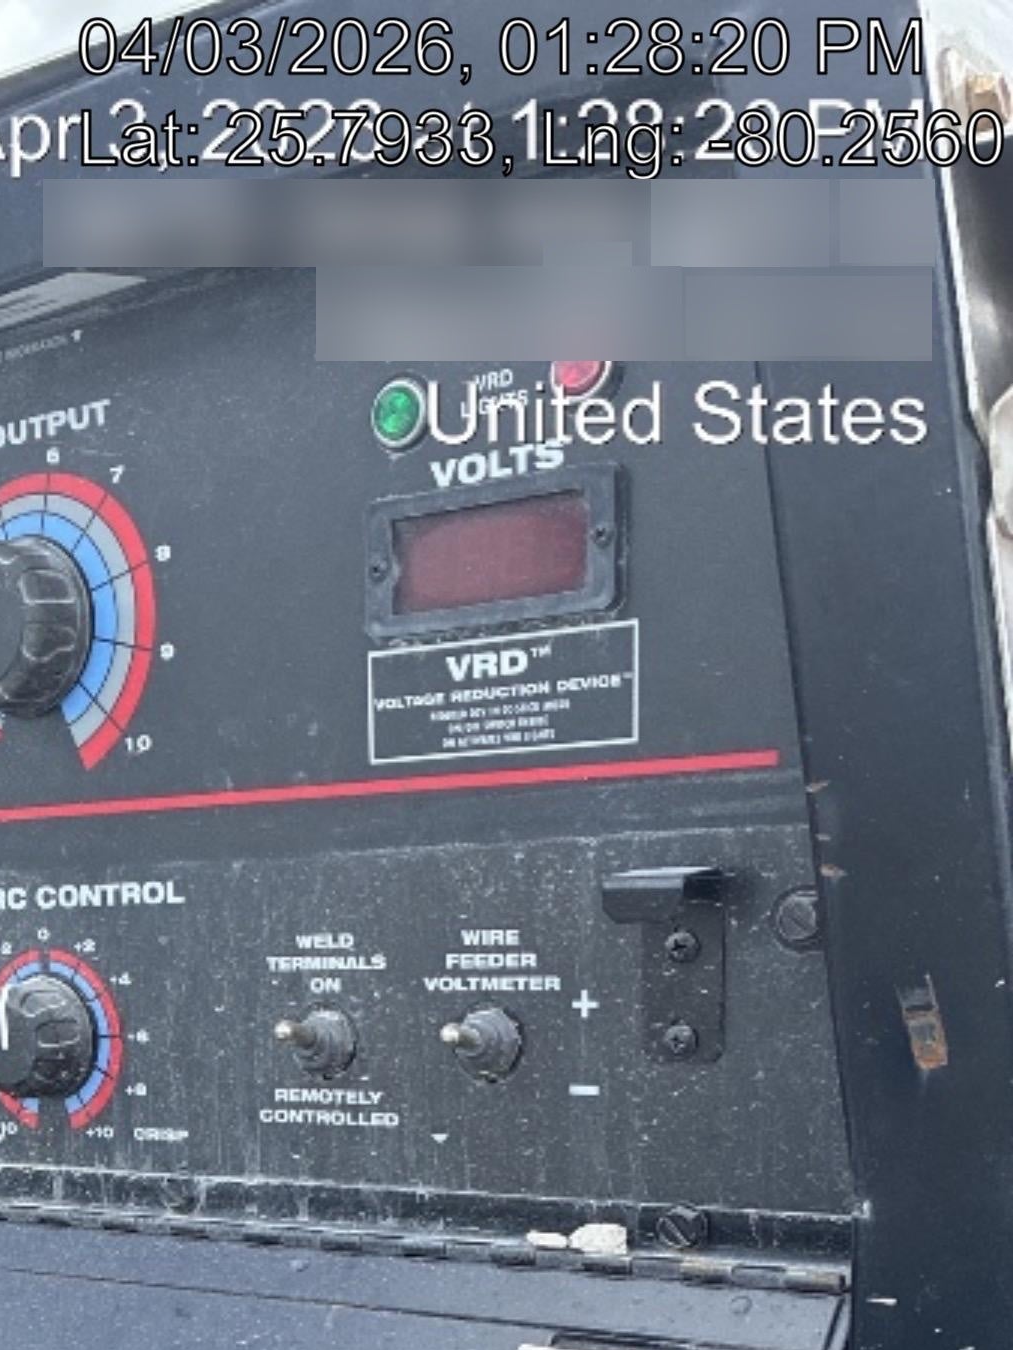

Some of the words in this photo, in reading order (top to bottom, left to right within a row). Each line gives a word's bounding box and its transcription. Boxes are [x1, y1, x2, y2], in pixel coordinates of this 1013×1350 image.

[46, 448, 60, 464] 6
[430, 438, 565, 488] VOLTS
[109, 465, 125, 483] 7
[374, 692, 445, 711] VOLTAGE
[451, 681, 550, 704] REDUCTION
[124, 734, 152, 752] 10
[36, 881, 186, 909] CONTROL
[296, 933, 354, 950] WELD
[461, 929, 520, 946] WIRE
[267, 953, 387, 972] TERMINALS
[446, 953, 537, 969] FEEDER
[310, 977, 342, 993] ON
[423, 976, 561, 992] VOLTMETER
[274, 1088, 383, 1106] REMOTELY
[260, 1109, 400, 1127] CONTROLLED
